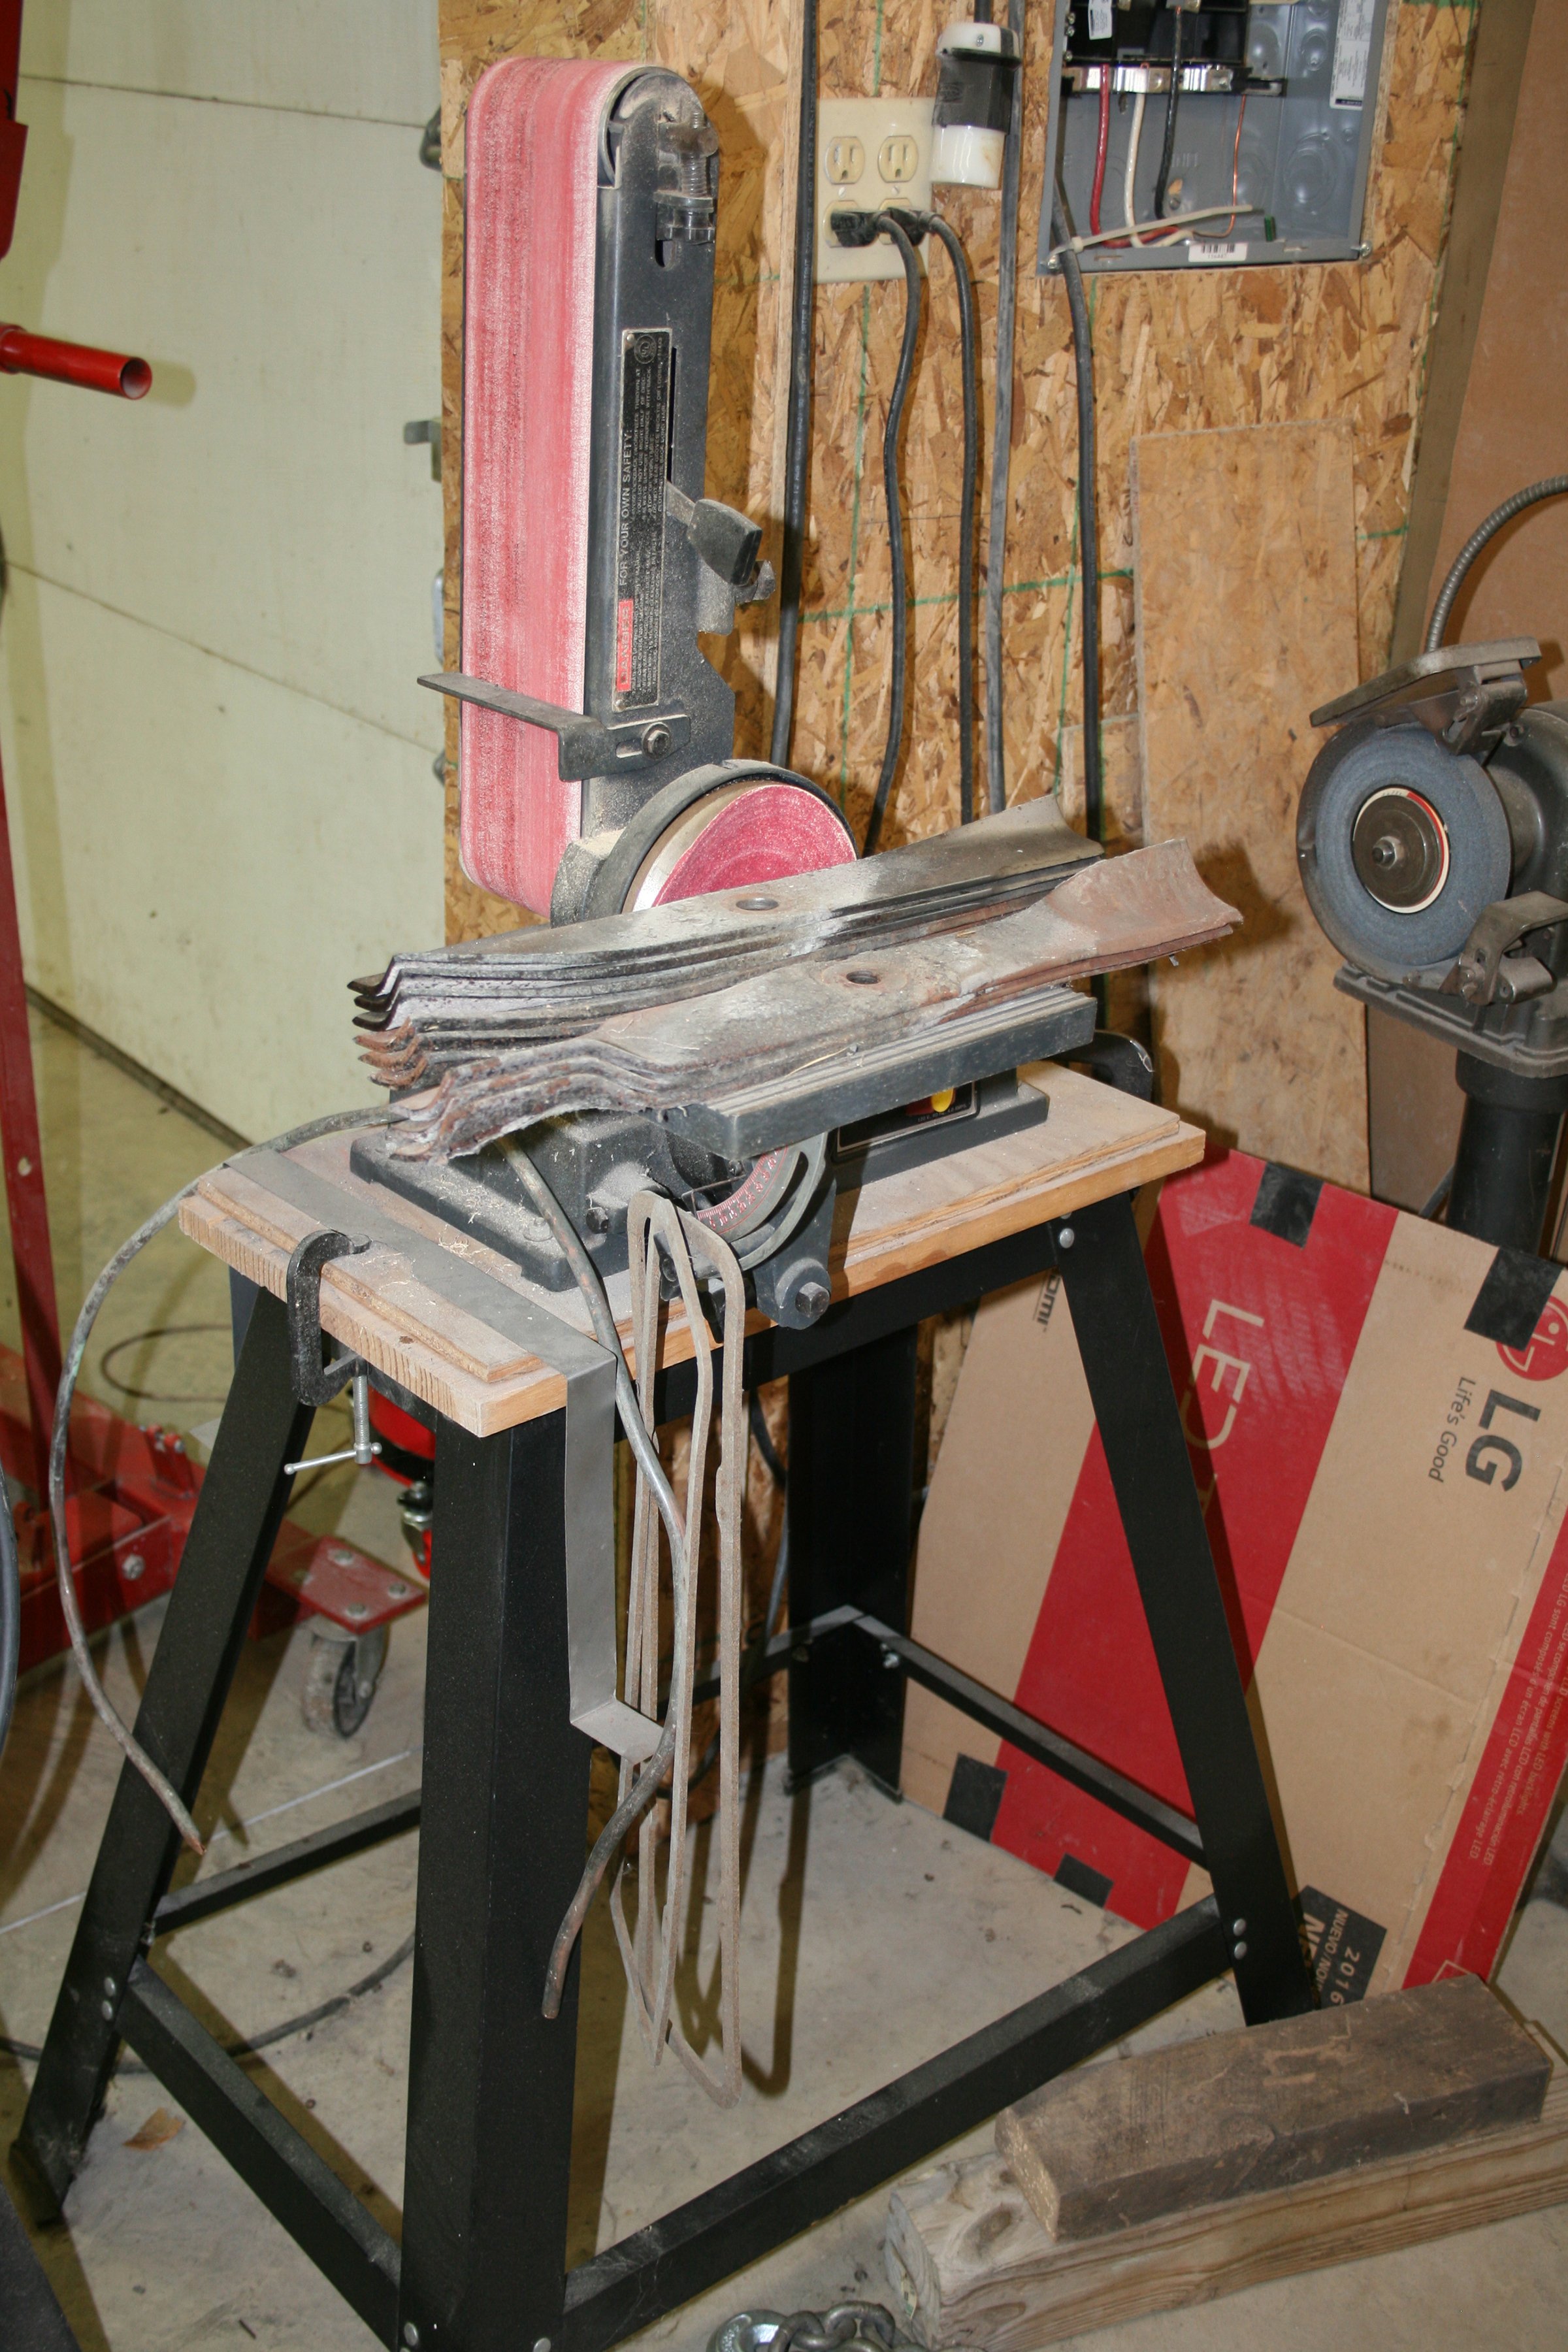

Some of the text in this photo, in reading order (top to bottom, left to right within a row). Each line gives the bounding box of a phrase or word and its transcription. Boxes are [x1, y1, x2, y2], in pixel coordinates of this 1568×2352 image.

[619, 429, 633, 585] FOR YOUR OWN SAFETY:
[1428, 1376, 1477, 1483] Life's Good
[1465, 1388, 1542, 1492] LG
[1556, 1593, 1565, 1607] LG
[1548, 1608, 1561, 1629] sont
[1531, 1630, 1553, 1677] composés
[1541, 1652, 1561, 1694] componen
[1524, 1678, 1537, 1699] d'un
[1514, 1699, 1530, 1726] écran
[1538, 1695, 1548, 1708] de
[1546, 1695, 1563, 1729] screens
[1508, 1727, 1520, 1747] LCD
[1524, 1707, 1545, 1747] pantallas
[1539, 1731, 1552, 1752] with
[1499, 1748, 1512, 1769] avec
[1518, 1746, 1529, 1765] LCD
[1532, 1752, 1544, 1771] LED
[1512, 1765, 1522, 1781] con
[1473, 1770, 1505, 1839] rétro-éclairage
[1330, 1946, 1360, 2005] 2016
